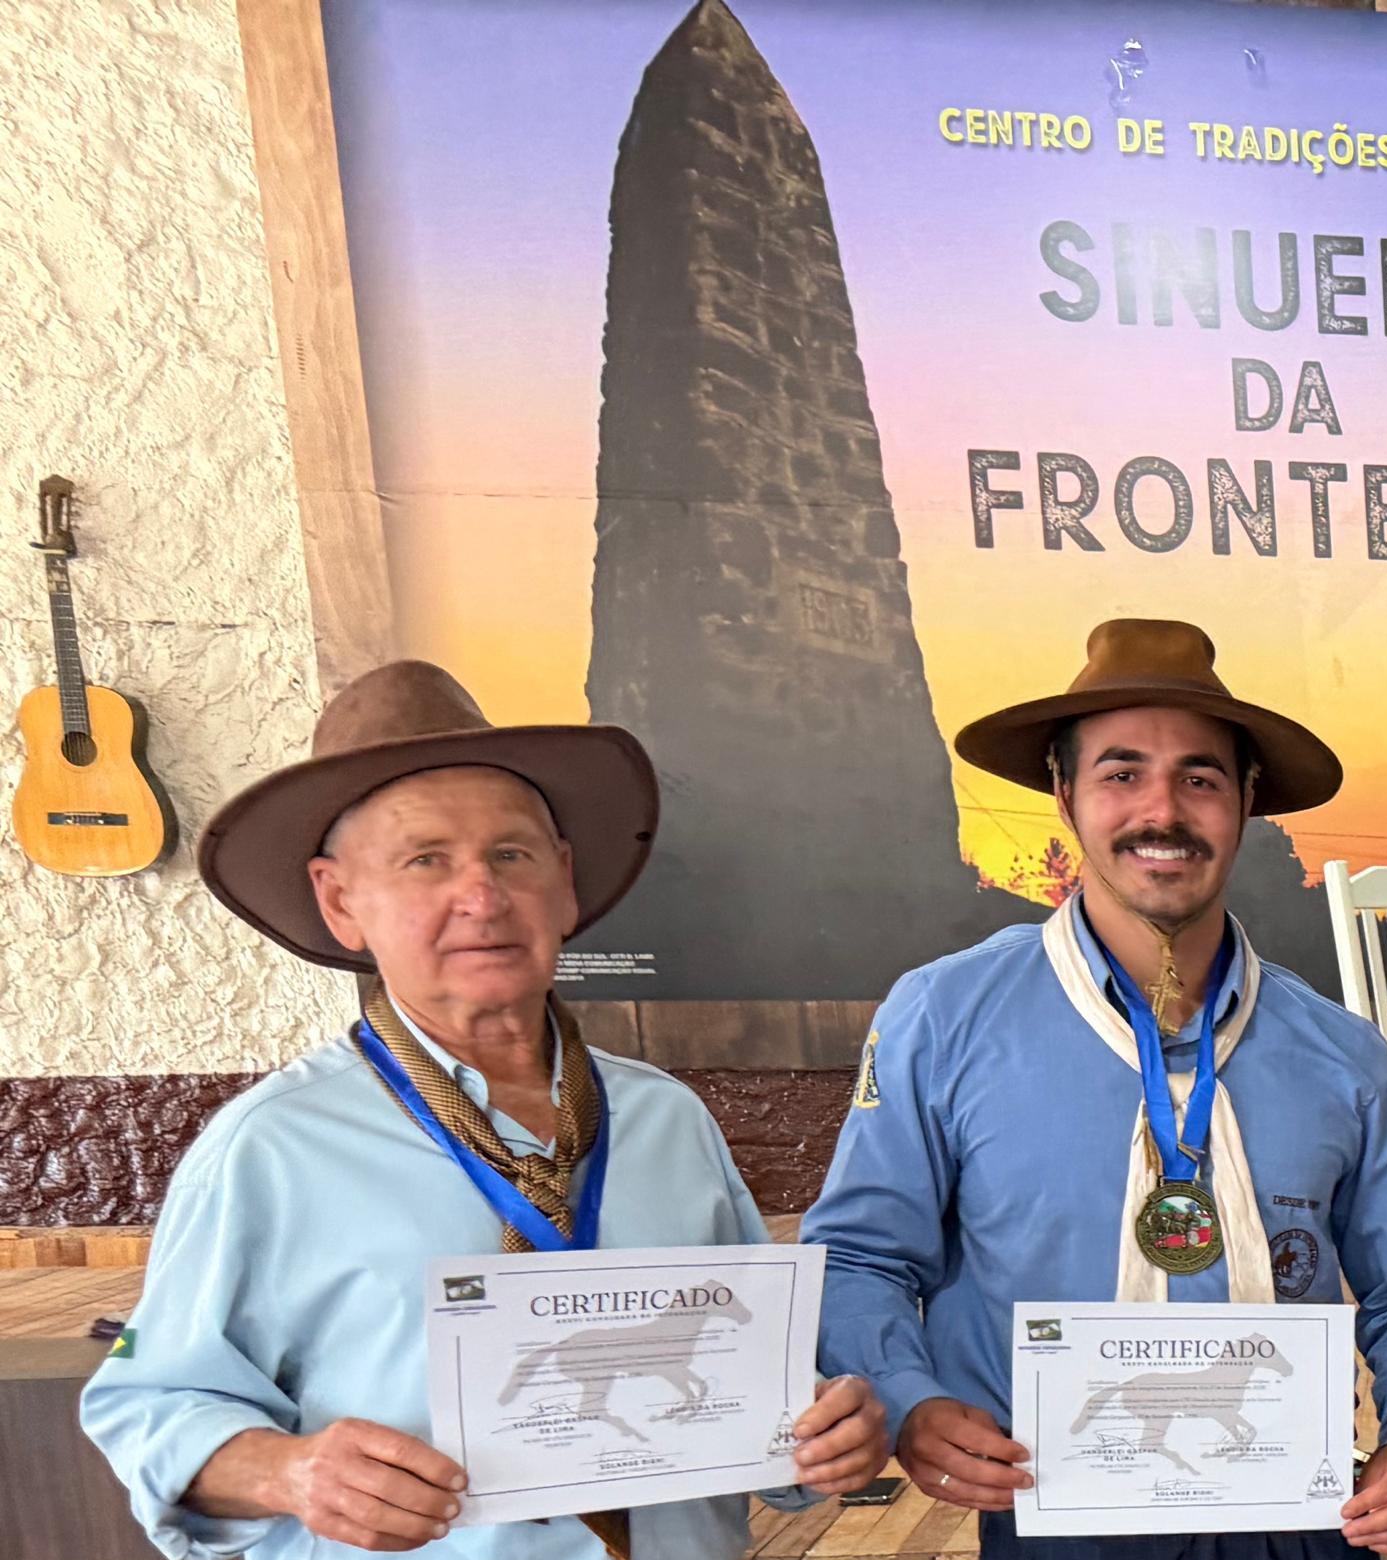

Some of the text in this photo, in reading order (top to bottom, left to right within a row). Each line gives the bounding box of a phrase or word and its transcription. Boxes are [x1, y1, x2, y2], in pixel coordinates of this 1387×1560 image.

[938, 107, 1092, 150] CENTRO
[1117, 118, 1165, 155] DE
[1231, 357, 1343, 436] DA
[529, 1286, 734, 1318] CERTIFICADO
[1099, 1338, 1277, 1361] CERTIFICADO
